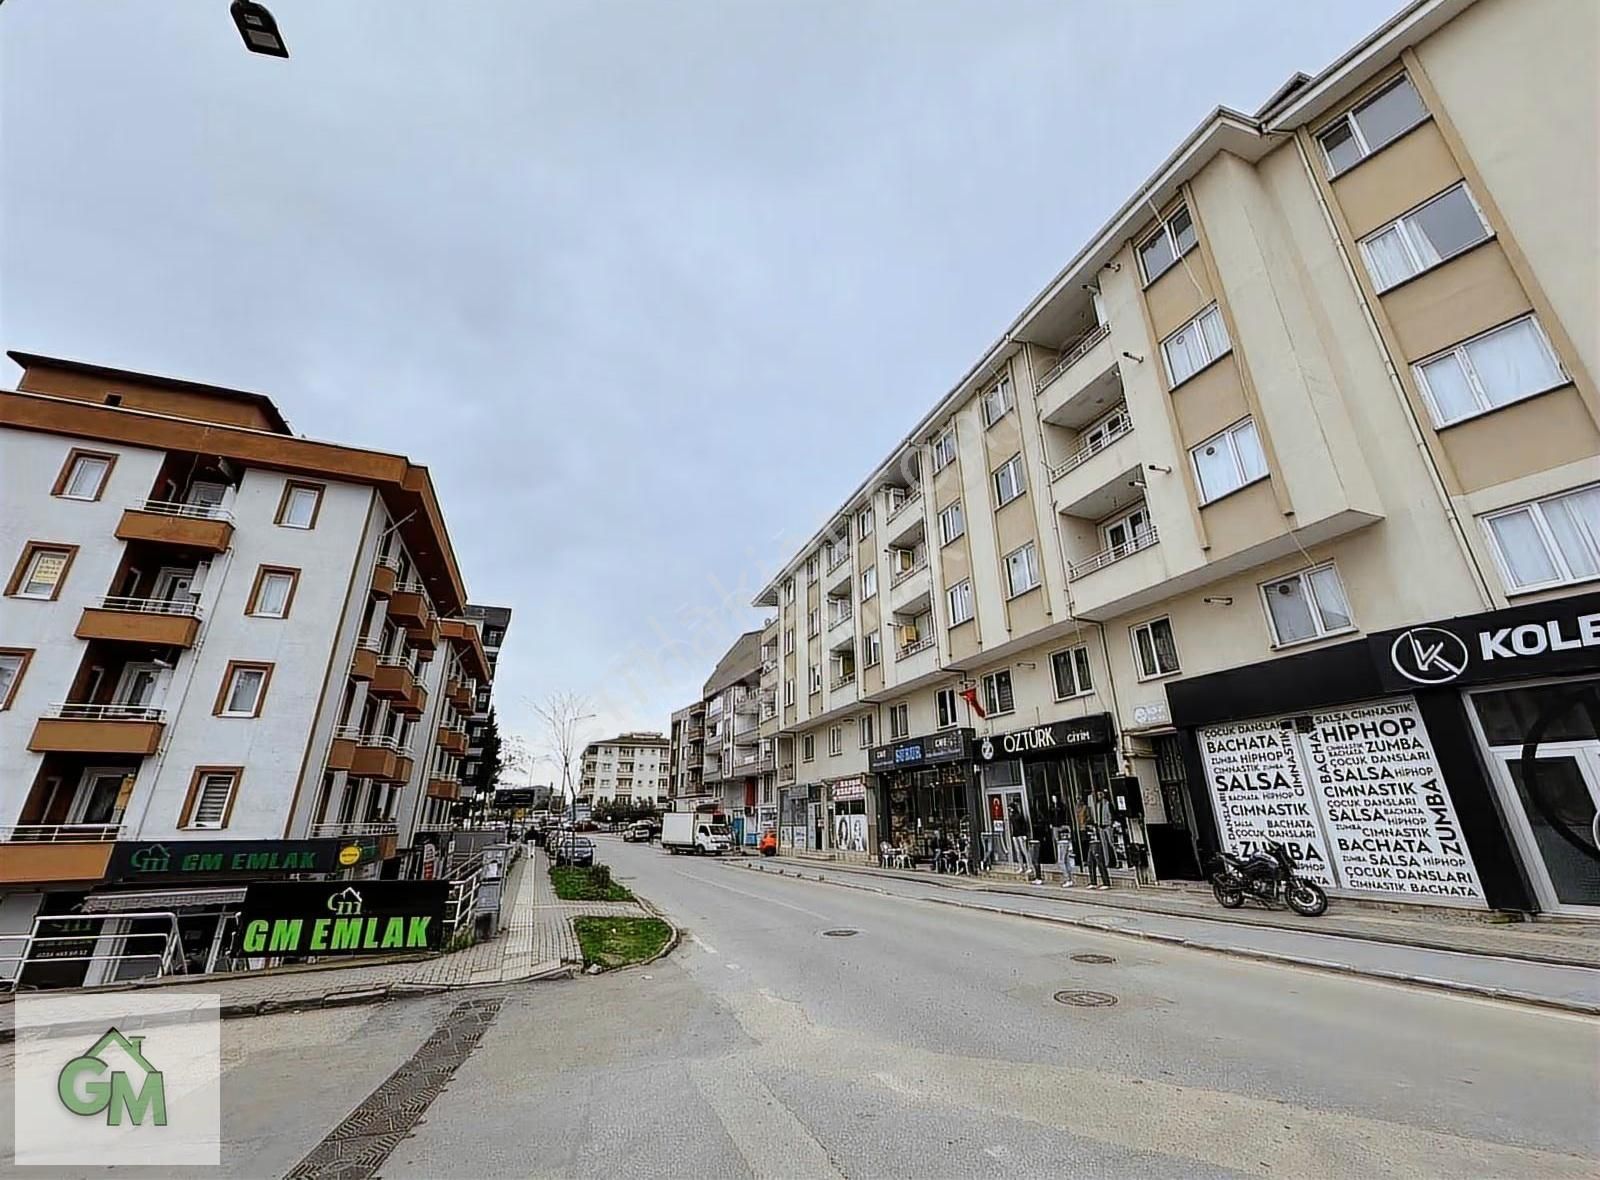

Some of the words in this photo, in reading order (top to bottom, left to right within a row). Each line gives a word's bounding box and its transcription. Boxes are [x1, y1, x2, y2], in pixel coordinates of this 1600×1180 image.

[1479, 613, 1600, 661] KOLE
[1315, 713, 1350, 724] SALSA
[1204, 727, 1236, 740] ÇOCUK
[1322, 717, 1416, 743] HİPHOP
[1003, 727, 1056, 753] ÖZTÜRK
[1207, 735, 1279, 753] BACHATA
[1365, 737, 1424, 753] ZUMBA
[1240, 751, 1283, 764] HİPHOP
[1308, 725, 1332, 784] BACHA
[1330, 757, 1368, 768] ÇOCUK
[1371, 752, 1431, 764] DANSLARI
[1215, 771, 1291, 792] SALSA
[1333, 766, 1395, 782] SALSA
[1395, 766, 1433, 777] HİPHOP
[1324, 782, 1418, 797] CIMNASTIK
[1231, 803, 1310, 816] CIMNASTIK
[1327, 800, 1361, 808] ÇOCUK
[1364, 798, 1416, 807] DANSLARI
[1329, 808, 1386, 821] SALSA
[1388, 817, 1427, 826] HİPHOP
[1421, 778, 1464, 857] ZUMBA
[1267, 820, 1314, 829] BACHATA
[1268, 829, 1316, 838] DANSLARI
[1362, 828, 1431, 838] CIMNASTIK
[1240, 841, 1323, 861] ZUBA
[1338, 838, 1432, 853] BACHATA
[181, 853, 223, 872] GM
[231, 852, 318, 870] EMLAK
[1369, 854, 1421, 867] SALSA
[1423, 856, 1466, 867] HİPHOP
[1345, 866, 1392, 879] ÇOCUK
[1395, 869, 1473, 884] DANSLARI
[1350, 880, 1407, 891] CIMNASTIK
[1410, 883, 1479, 897] BACHATA
[242, 919, 303, 952] GM
[310, 915, 432, 951] EMLAK
